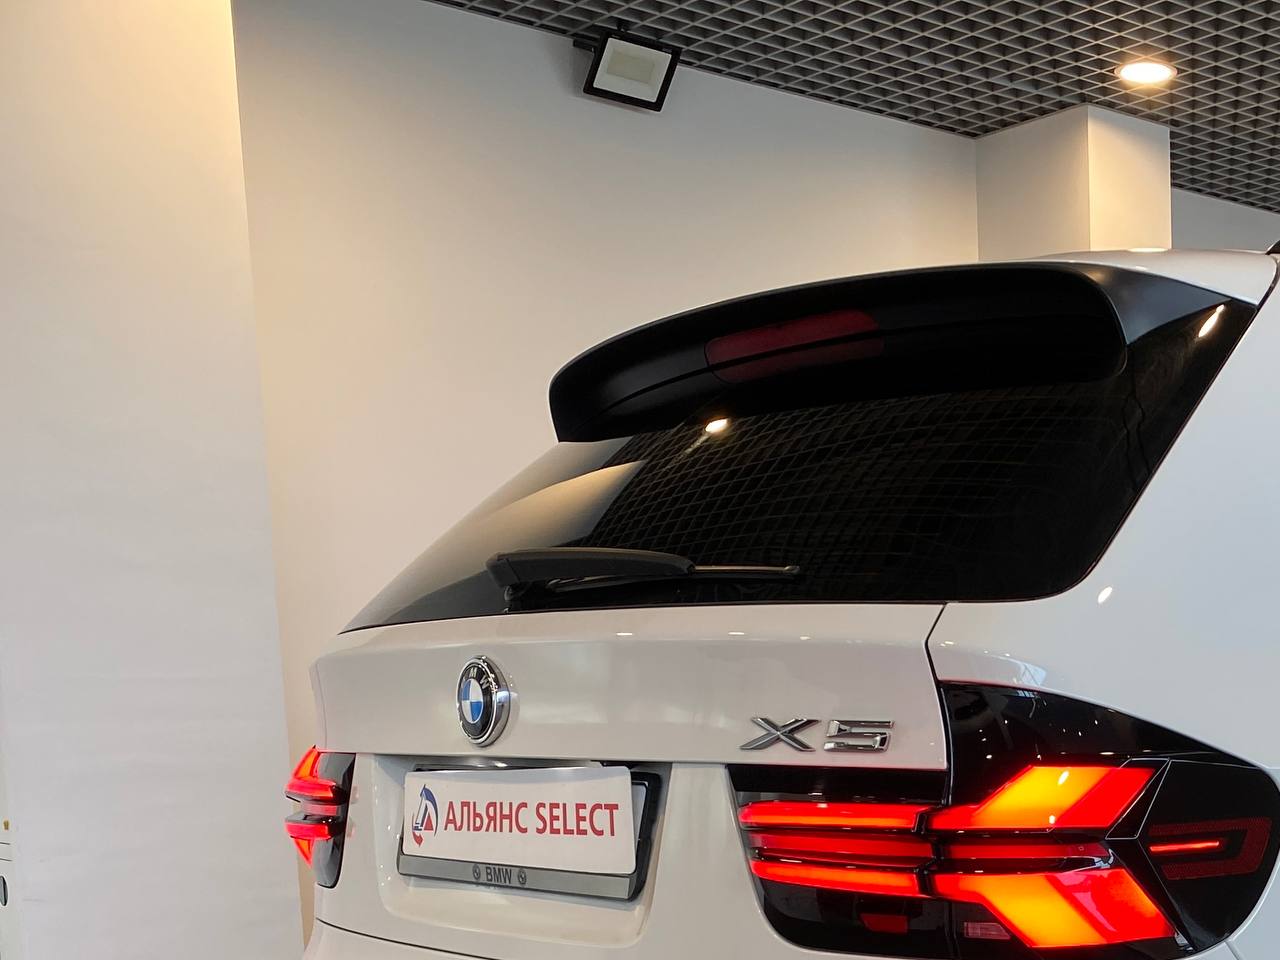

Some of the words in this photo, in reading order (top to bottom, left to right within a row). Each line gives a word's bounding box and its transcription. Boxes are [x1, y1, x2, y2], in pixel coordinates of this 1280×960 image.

[739, 717, 895, 752] X5
[444, 801, 528, 833] АЛЬЯНС
[535, 802, 619, 837] SELECT
[485, 866, 512, 884] BMW
